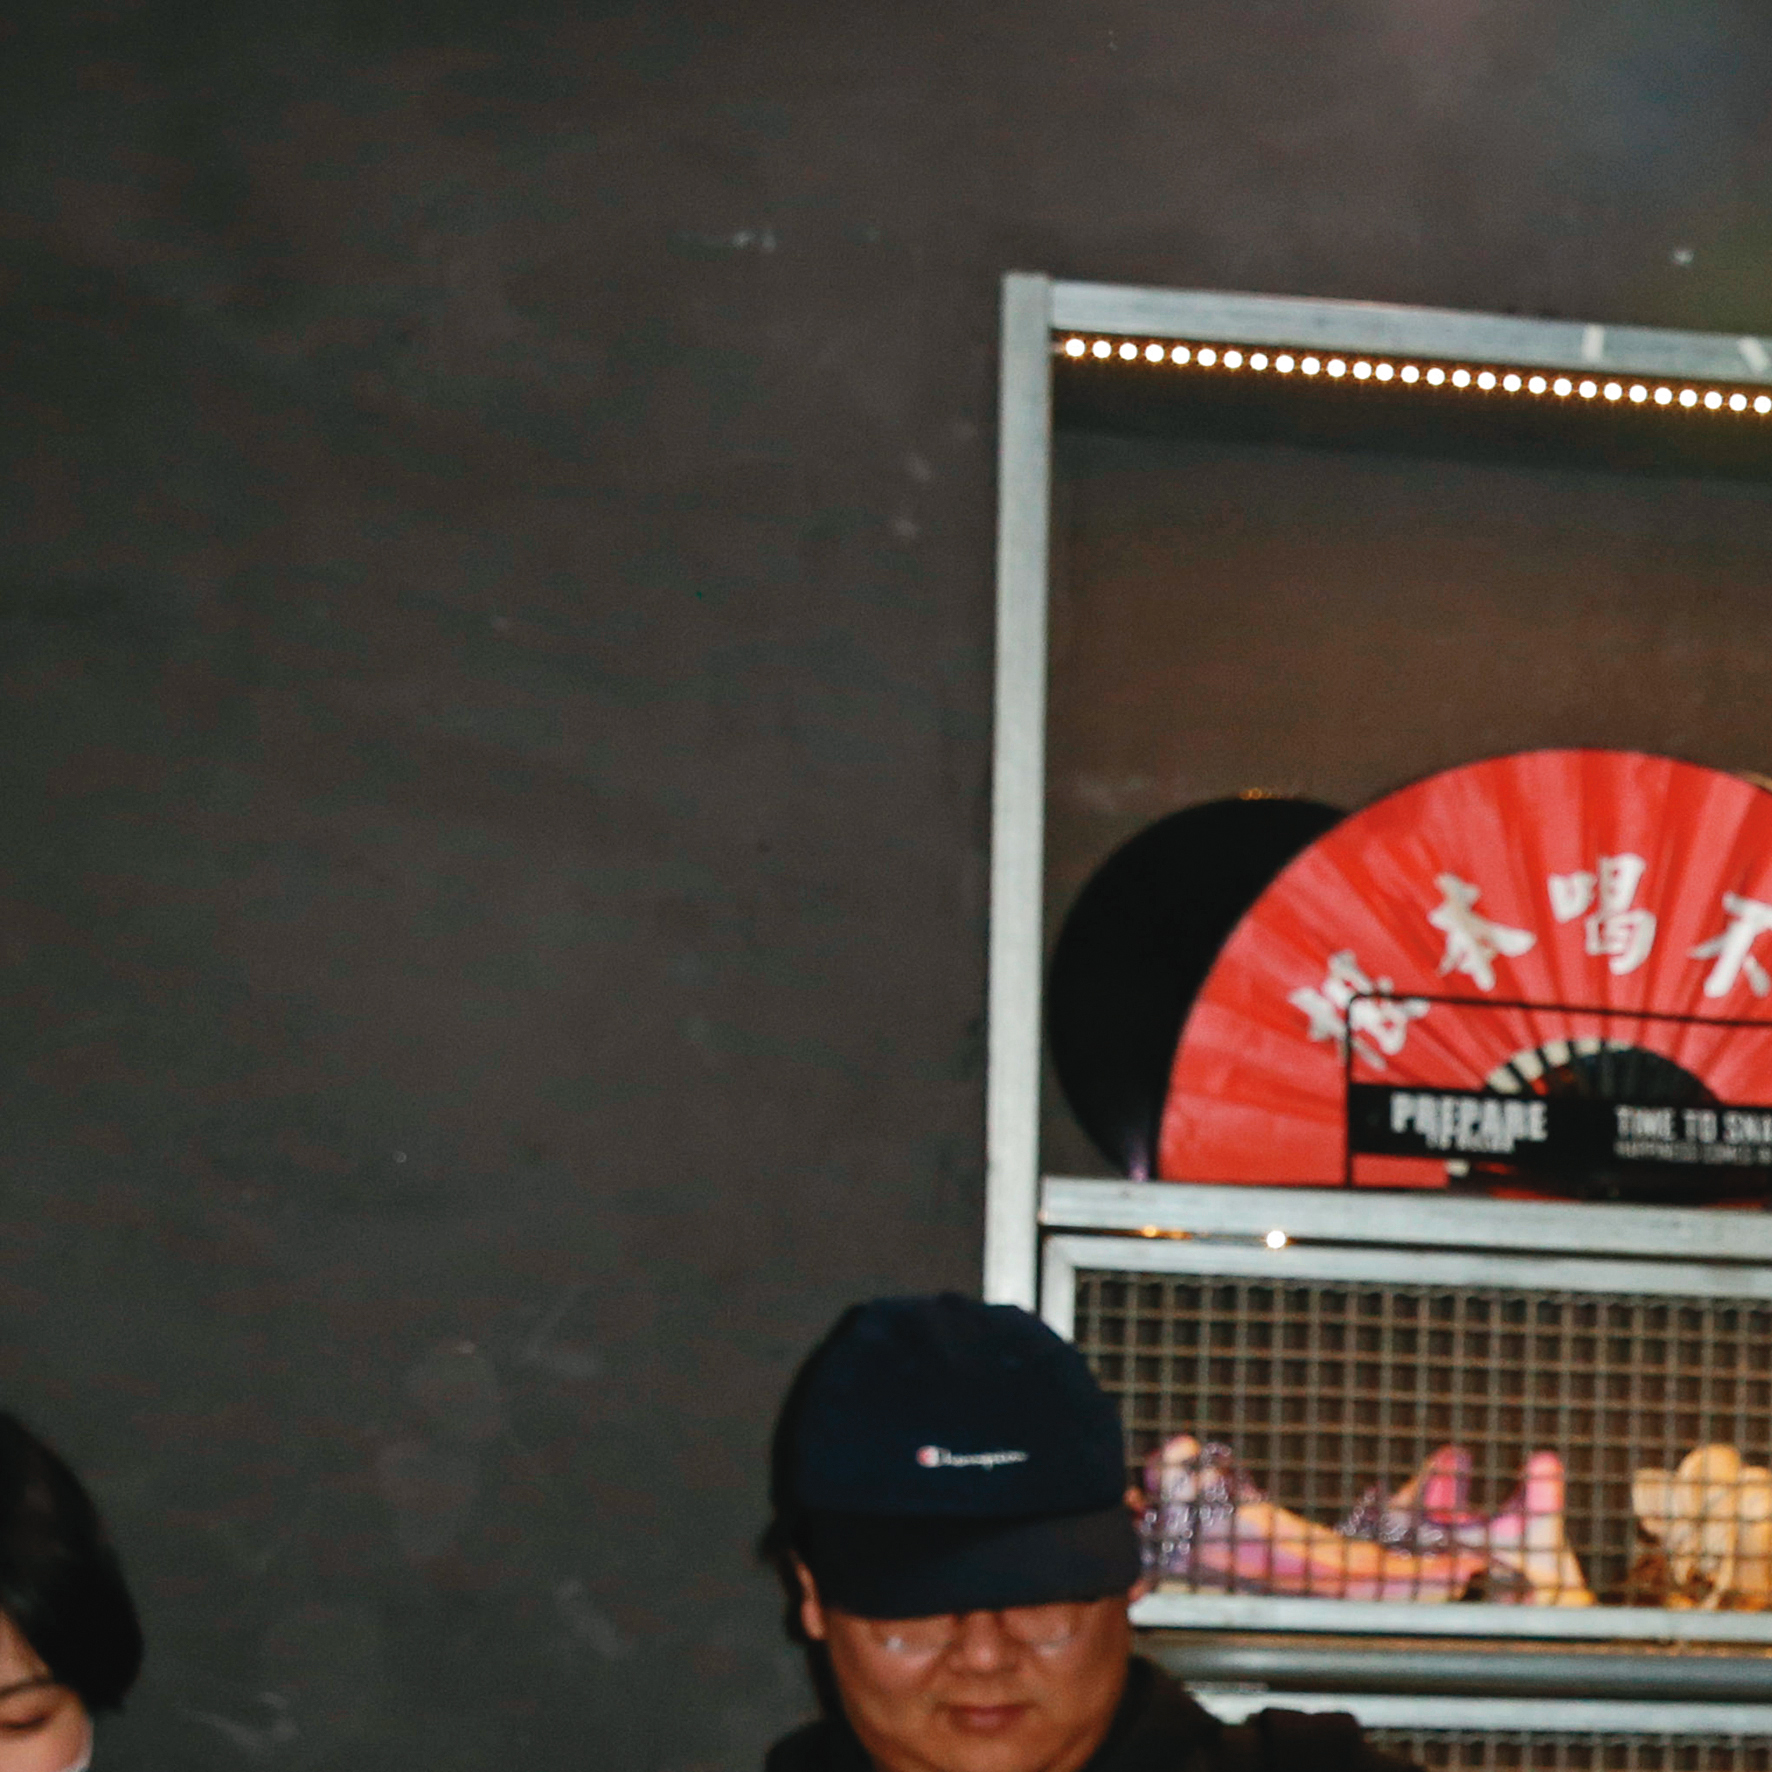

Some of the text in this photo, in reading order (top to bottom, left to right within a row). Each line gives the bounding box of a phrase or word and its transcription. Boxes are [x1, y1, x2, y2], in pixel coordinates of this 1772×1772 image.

[1390, 1091, 1548, 1142] PREPARE
[1616, 1105, 1675, 1141] TIME
[1684, 1108, 1718, 1144] TO
